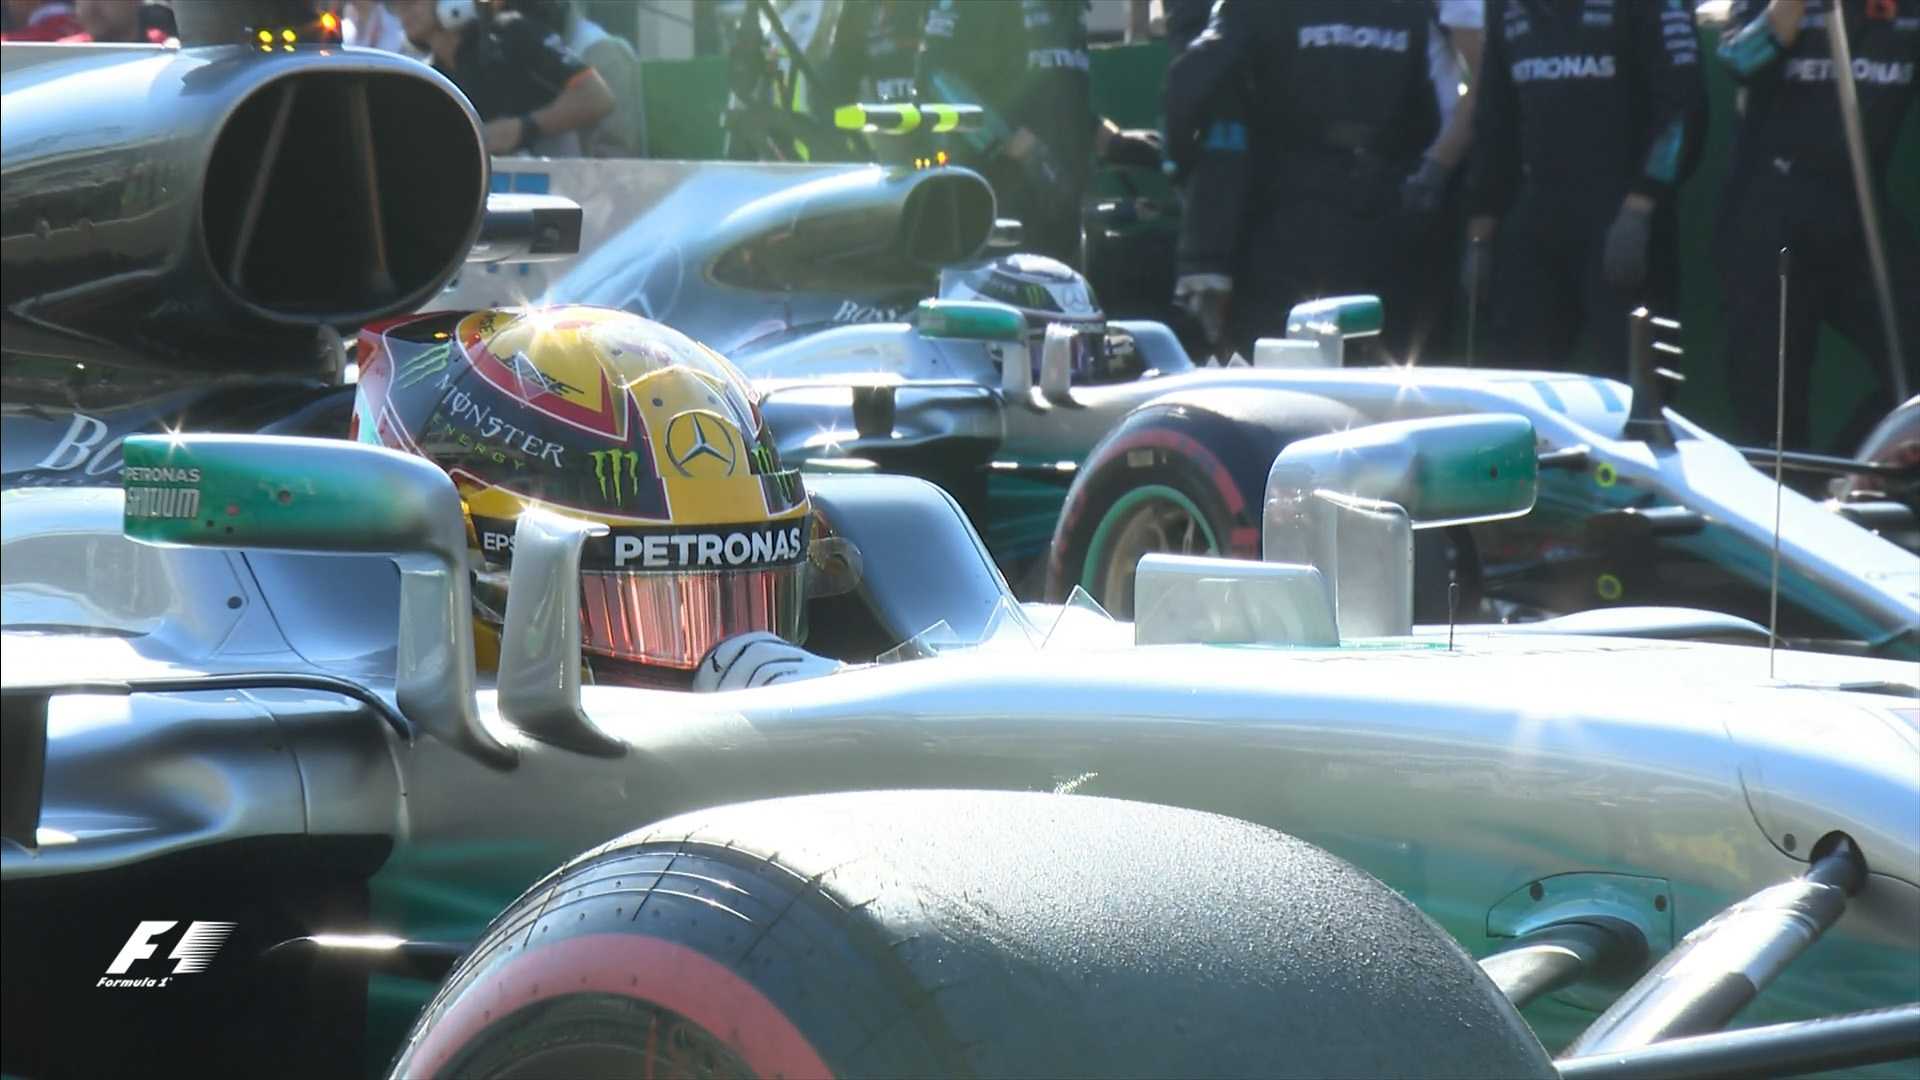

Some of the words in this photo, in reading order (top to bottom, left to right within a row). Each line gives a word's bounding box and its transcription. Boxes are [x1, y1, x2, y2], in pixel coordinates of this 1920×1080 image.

[435, 373, 565, 468] MONSTER
[125, 466, 200, 483] PETRONAS
[614, 527, 801, 568] PETRONAS
